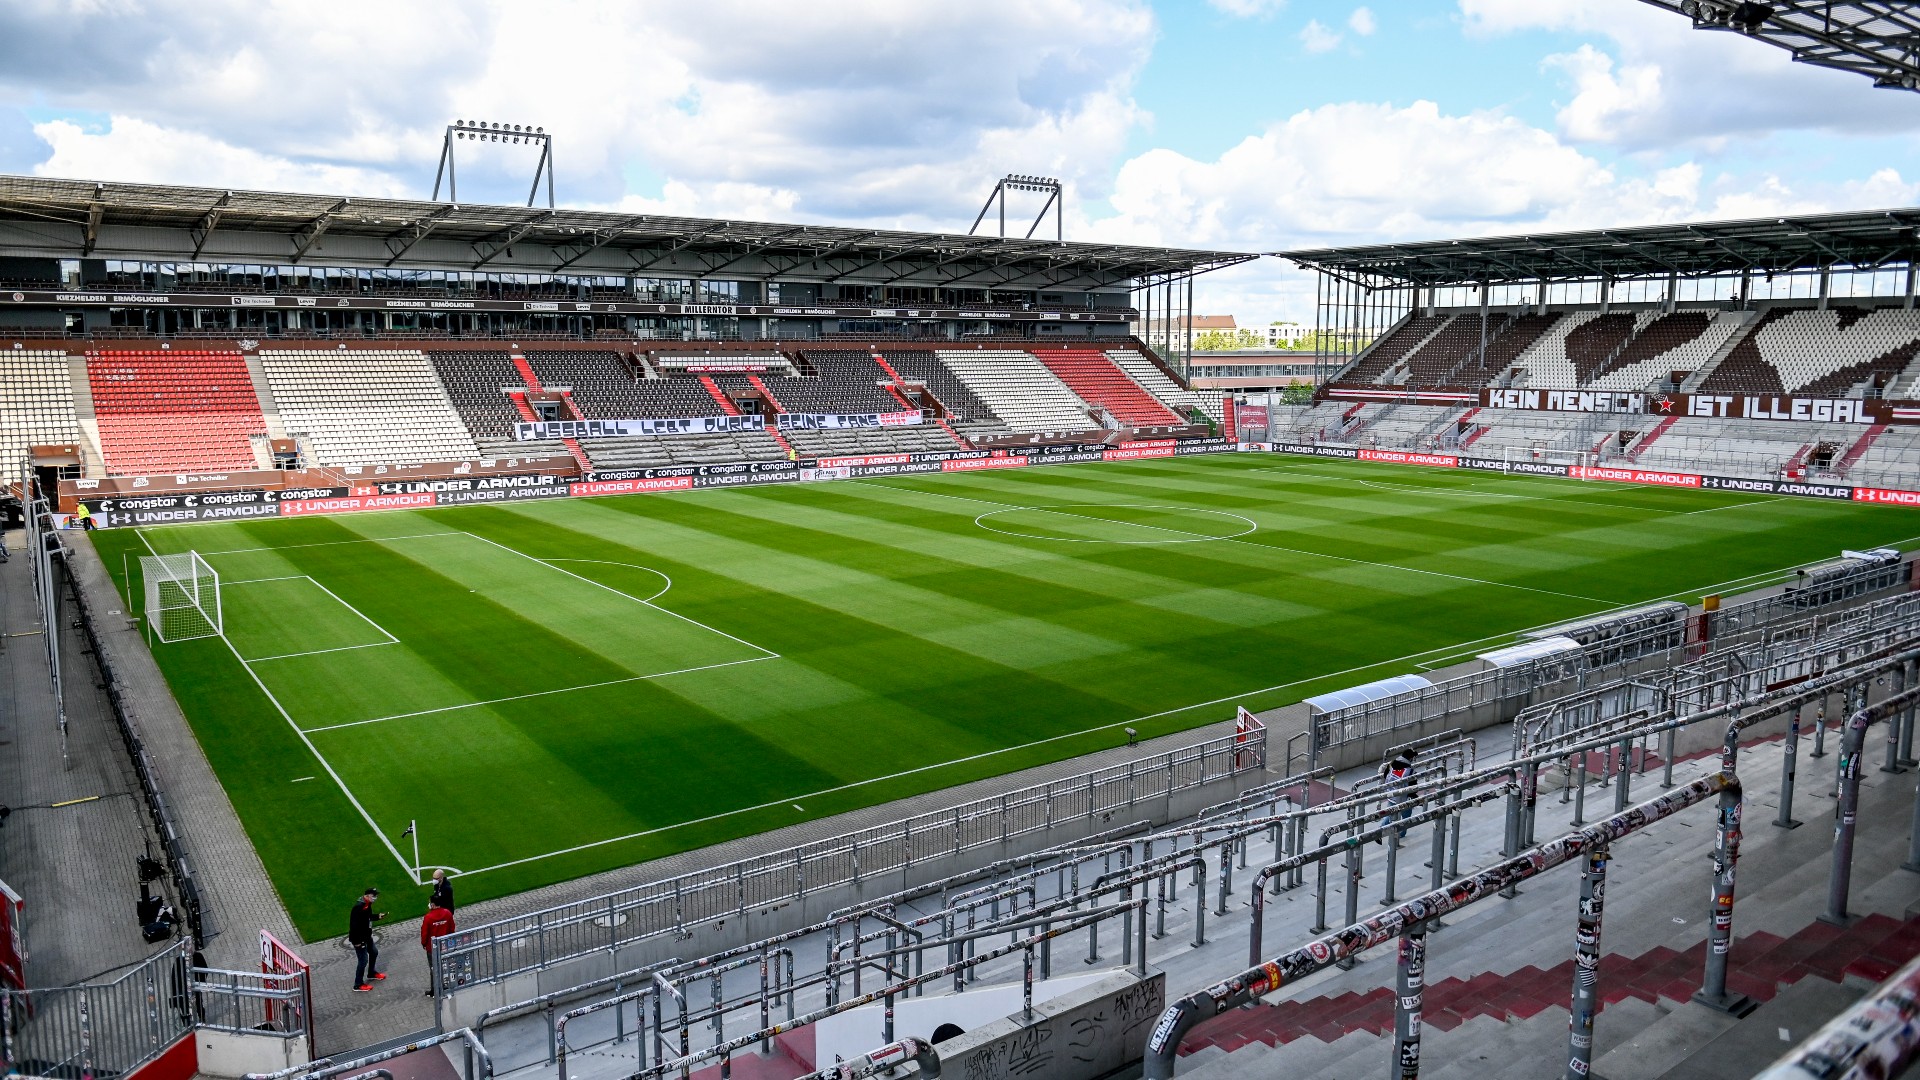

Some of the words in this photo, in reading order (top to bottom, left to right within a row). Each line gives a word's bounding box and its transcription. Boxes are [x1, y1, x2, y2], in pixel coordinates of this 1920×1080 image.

[113, 294, 170, 303] ERMÖGLICHER
[1489, 389, 1539, 409] KEIN
[1546, 390, 1644, 414] MENSCH
[1687, 395, 1732, 417] IST
[1742, 396, 1875, 423] ILLEGAL
[519, 420, 629, 440] FUSSBALL
[641, 420, 691, 434] LEBT
[704, 415, 763, 432] DURCH
[779, 414, 828, 429] SEINE
[837, 414, 879, 427] FANS
[1052, 446, 1073, 454] congstar
[1129, 442, 1149, 450] UNDER
[1150, 440, 1174, 448] ARMOUR
[1183, 446, 1206, 454] UNDER
[1208, 444, 1236, 452] ARMOUR
[921, 453, 952, 462] UNDER
[1114, 450, 1139, 459] UNDER
[1140, 448, 1172, 456] ARMOUR
[1285, 445, 1314, 454] UNDER
[1316, 448, 1356, 458] ARMOUR
[833, 458, 865, 467] UNDER
[867, 456, 907, 465] ARMOUR
[956, 459, 986, 469] UNDER
[988, 457, 1024, 466] ARMOUR
[1038, 456, 1065, 464] UNDER
[1068, 453, 1101, 462] ARMOUR
[1372, 451, 1406, 461] UNDER
[1408, 455, 1453, 465] ARMOUR
[657, 467, 695, 478] congstar
[711, 464, 747, 474] congstar
[762, 461, 796, 472] congstar
[864, 465, 897, 474] UNDER
[900, 462, 941, 472] ARMOUR
[1472, 460, 1511, 470] UNDER
[1514, 465, 1566, 475] ARMOUR
[601, 470, 641, 481] congstar
[709, 475, 748, 484] UNDER
[751, 472, 798, 483] ARMOUR
[1588, 470, 1632, 480] UNDER
[1635, 472, 1696, 486] ARMOUR
[406, 481, 472, 494] UNDER
[477, 476, 554, 489] ARMOUR
[590, 483, 631, 493] UNDER
[636, 479, 689, 489] ARMOUR
[1722, 479, 1774, 491] UNDER
[1778, 484, 1849, 498] ARMOUR
[203, 493, 258, 505] congstar
[281, 488, 333, 500] congstar
[457, 489, 505, 502] UNDER
[509, 487, 568, 498] ARMOUR
[120, 498, 178, 510] congstar
[305, 499, 361, 511] UNDER
[365, 495, 431, 507] ARMOUR
[135, 510, 197, 522] UNDER
[202, 505, 277, 517] ARMOUR
